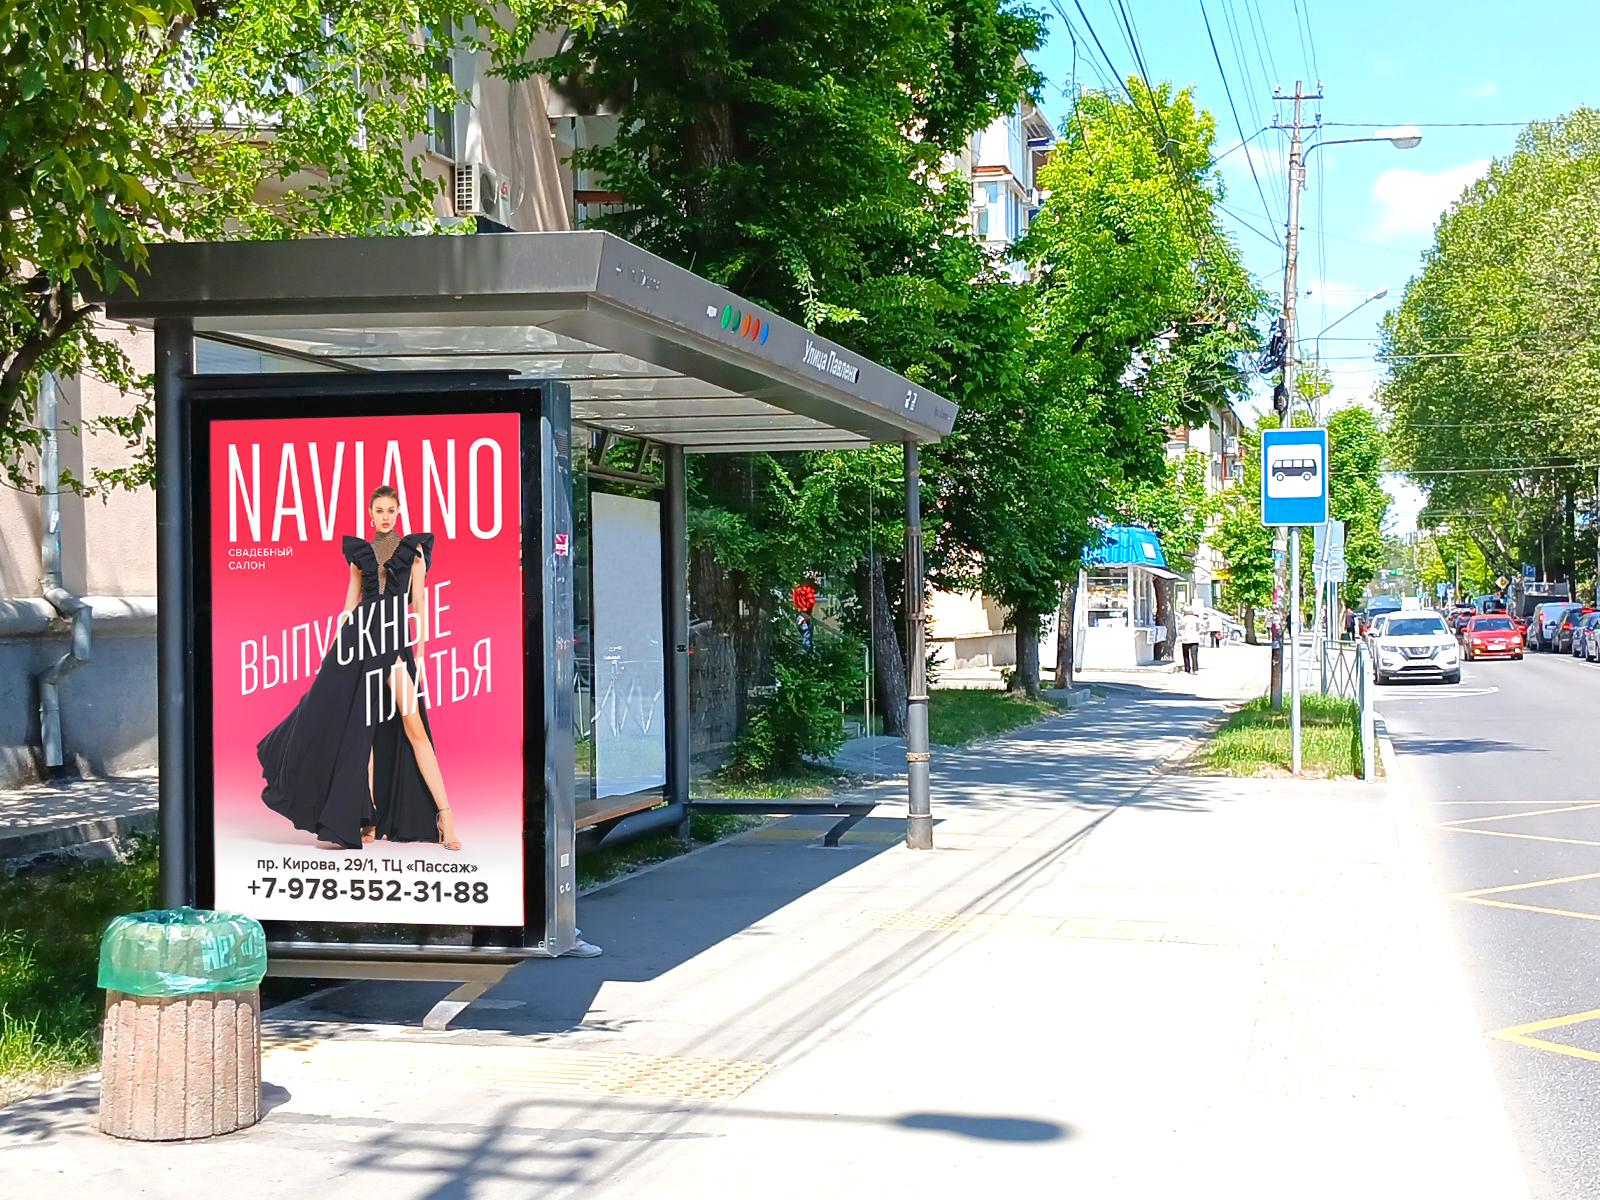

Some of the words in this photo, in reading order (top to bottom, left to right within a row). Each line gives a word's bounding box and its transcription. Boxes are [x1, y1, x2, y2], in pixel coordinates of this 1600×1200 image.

[802, 338, 829, 371] Улица
[227, 437, 503, 543] NAVIANO
[228, 545, 293, 558] СВАДЕБНЫЙ
[228, 561, 266, 570] САЛОН
[240, 579, 452, 696] ВЫПУСКНЫЕ
[365, 636, 492, 727] ПЛАТЬЯ
[257, 859, 280, 874] пр.
[282, 857, 340, 873] Кирова,
[344, 858, 379, 874] 29/1,
[381, 859, 403, 874] ТЦ
[406, 859, 479, 875] «Пассаж»
[247, 877, 490, 904] +7-978-552-31-88
